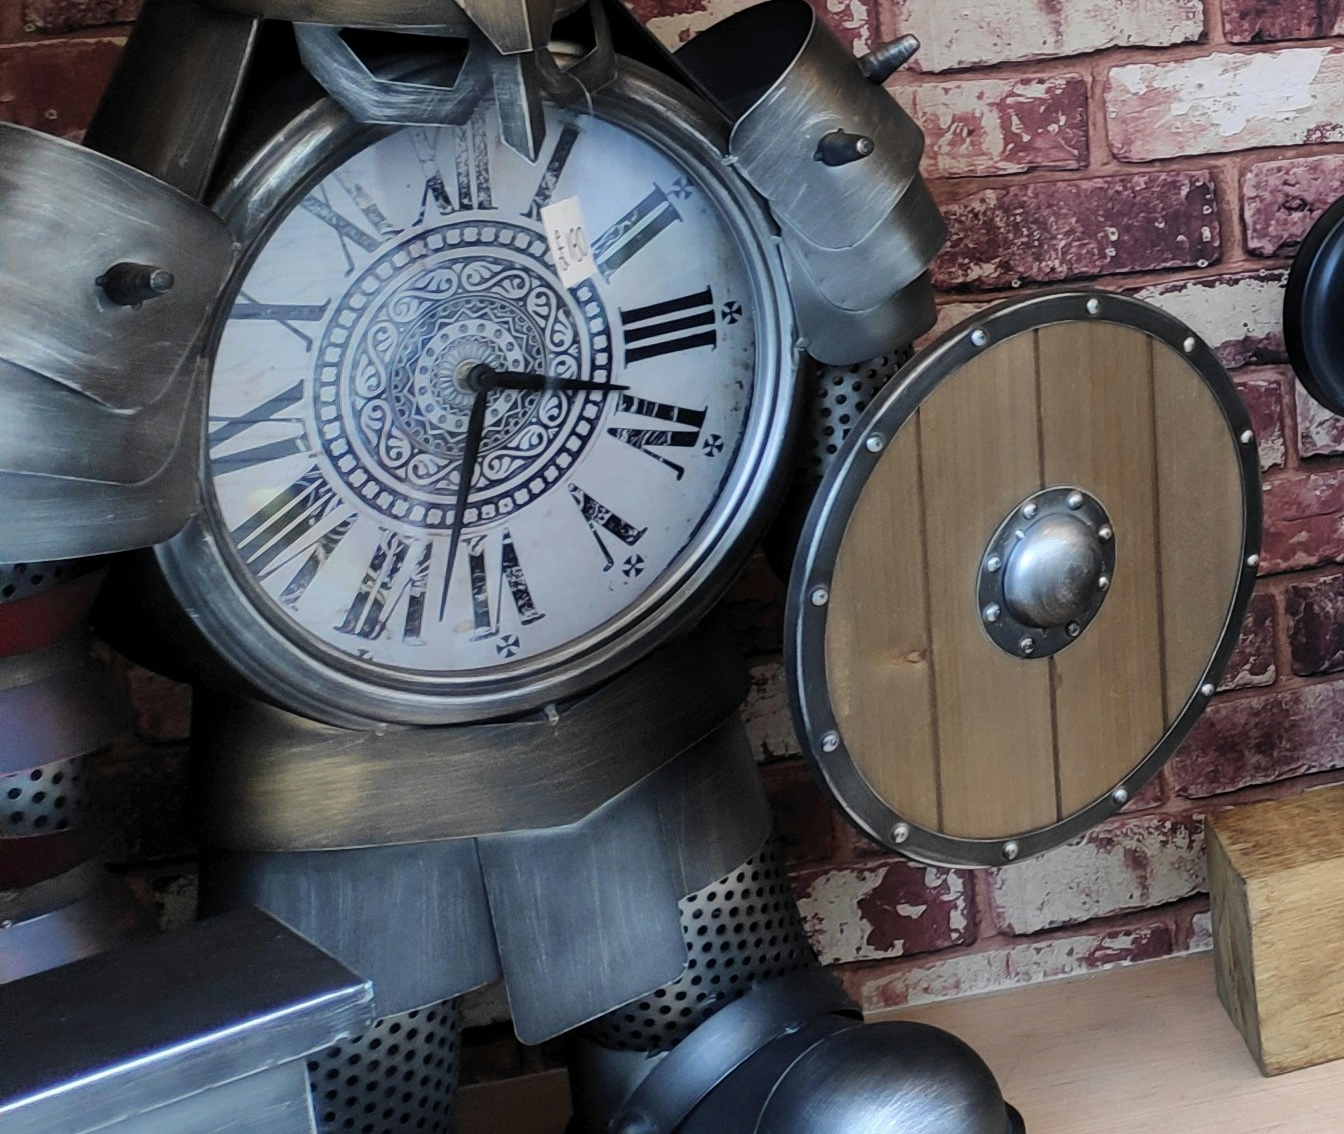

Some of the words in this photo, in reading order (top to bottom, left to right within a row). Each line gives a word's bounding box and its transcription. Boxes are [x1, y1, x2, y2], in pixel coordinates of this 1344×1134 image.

[590, 181, 684, 285] II
[617, 284, 718, 364] III
[606, 393, 708, 481] IV
[567, 482, 650, 573] V
